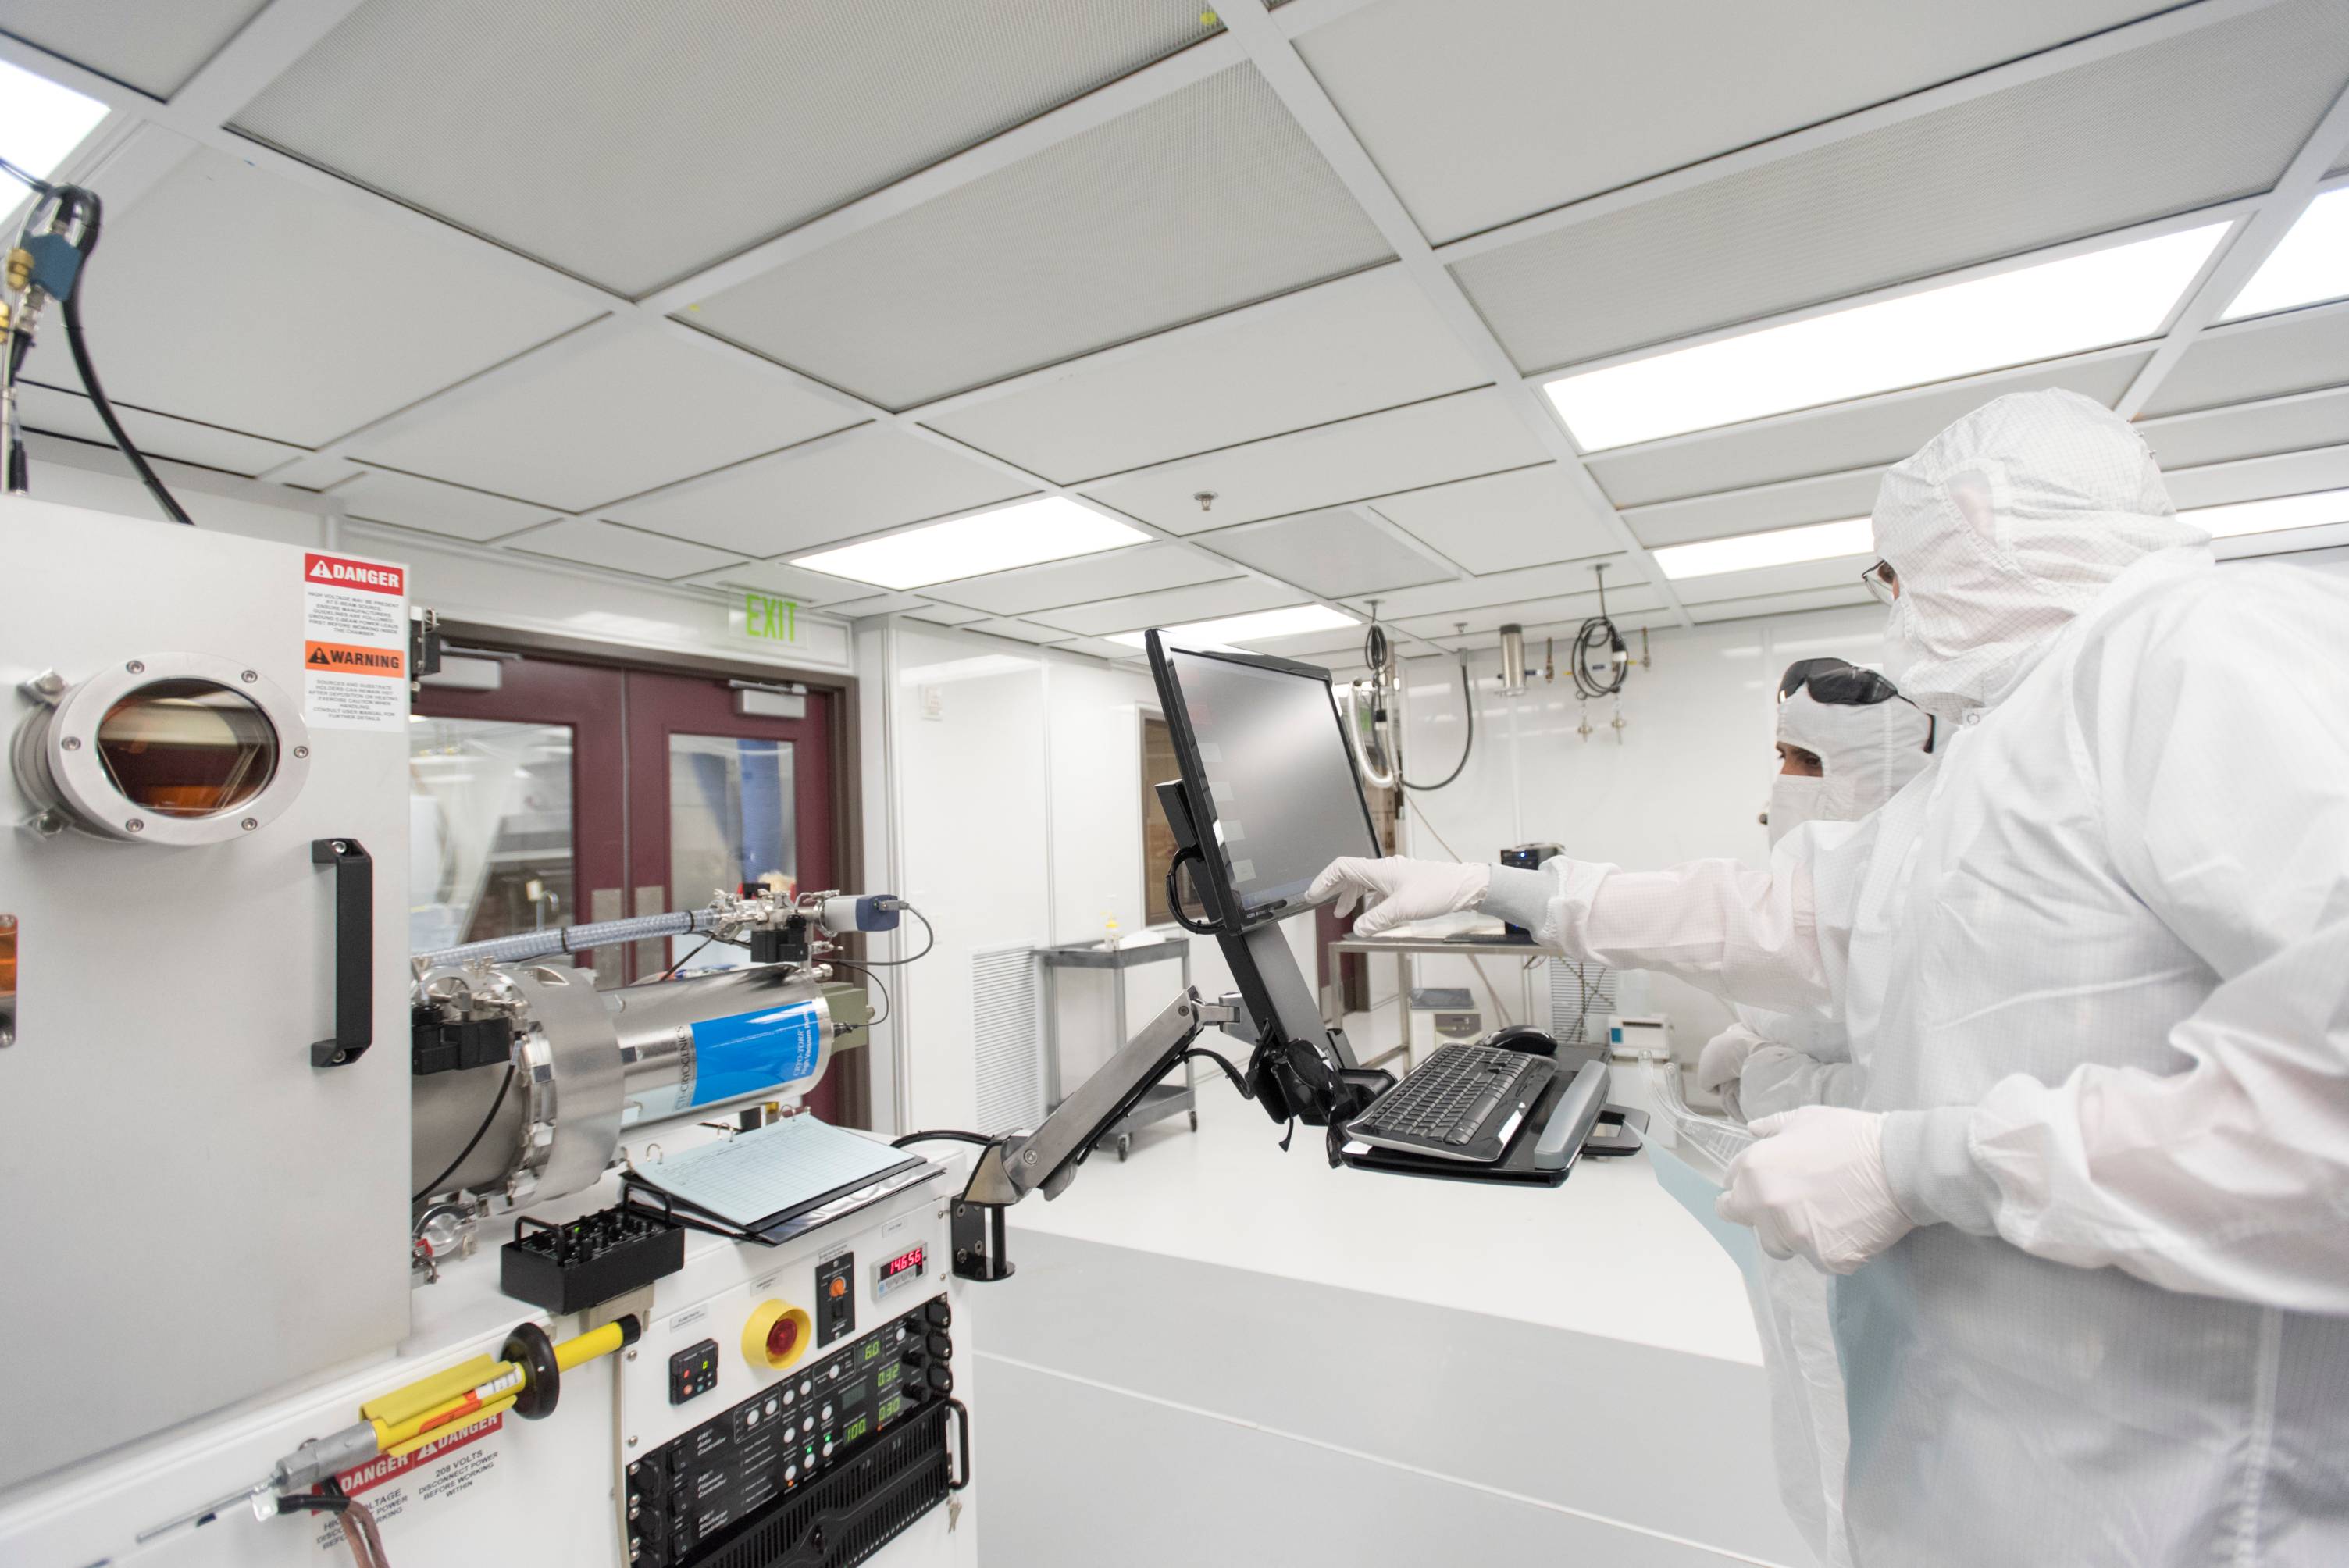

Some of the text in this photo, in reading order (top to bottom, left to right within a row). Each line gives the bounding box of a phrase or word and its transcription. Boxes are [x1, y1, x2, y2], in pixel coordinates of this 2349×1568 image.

[333, 564, 400, 588] DANGER
[745, 593, 798, 643] EXIT
[329, 649, 400, 669] WARNING
[436, 1414, 498, 1448] DANGER
[697, 1437, 726, 1456] Controller
[340, 1452, 410, 1493] DANGER
[419, 1451, 498, 1495] DISCONNECT POWER
[435, 1450, 483, 1478] 208 VOLTS
[423, 1463, 494, 1501] BEFORE WORKING
[446, 1481, 473, 1498] WITHIN
[698, 1478, 727, 1499] Controller
[376, 1495, 408, 1514] POWER
[323, 1506, 403, 1550] BEFO RKING
[700, 1517, 728, 1538] Controller
